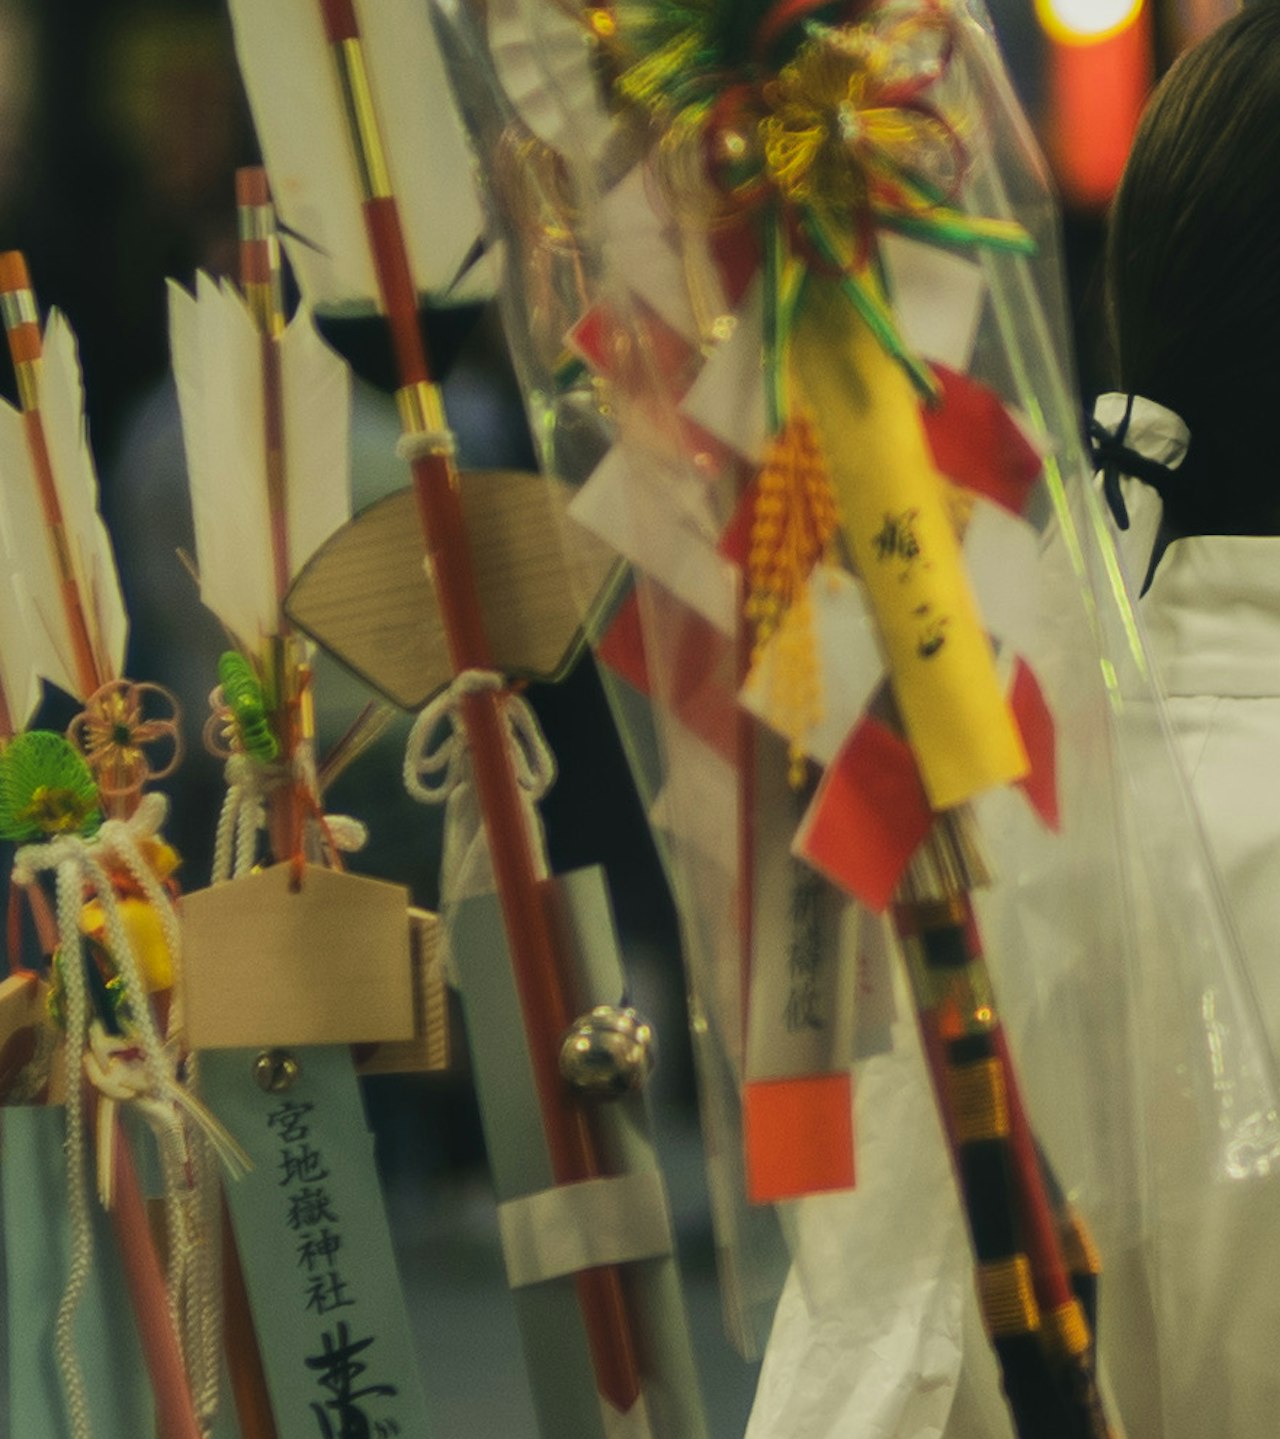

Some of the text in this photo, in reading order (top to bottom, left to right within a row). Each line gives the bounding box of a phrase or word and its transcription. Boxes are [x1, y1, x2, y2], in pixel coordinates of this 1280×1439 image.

[266, 1099, 356, 1316] 宮地嶽神社
